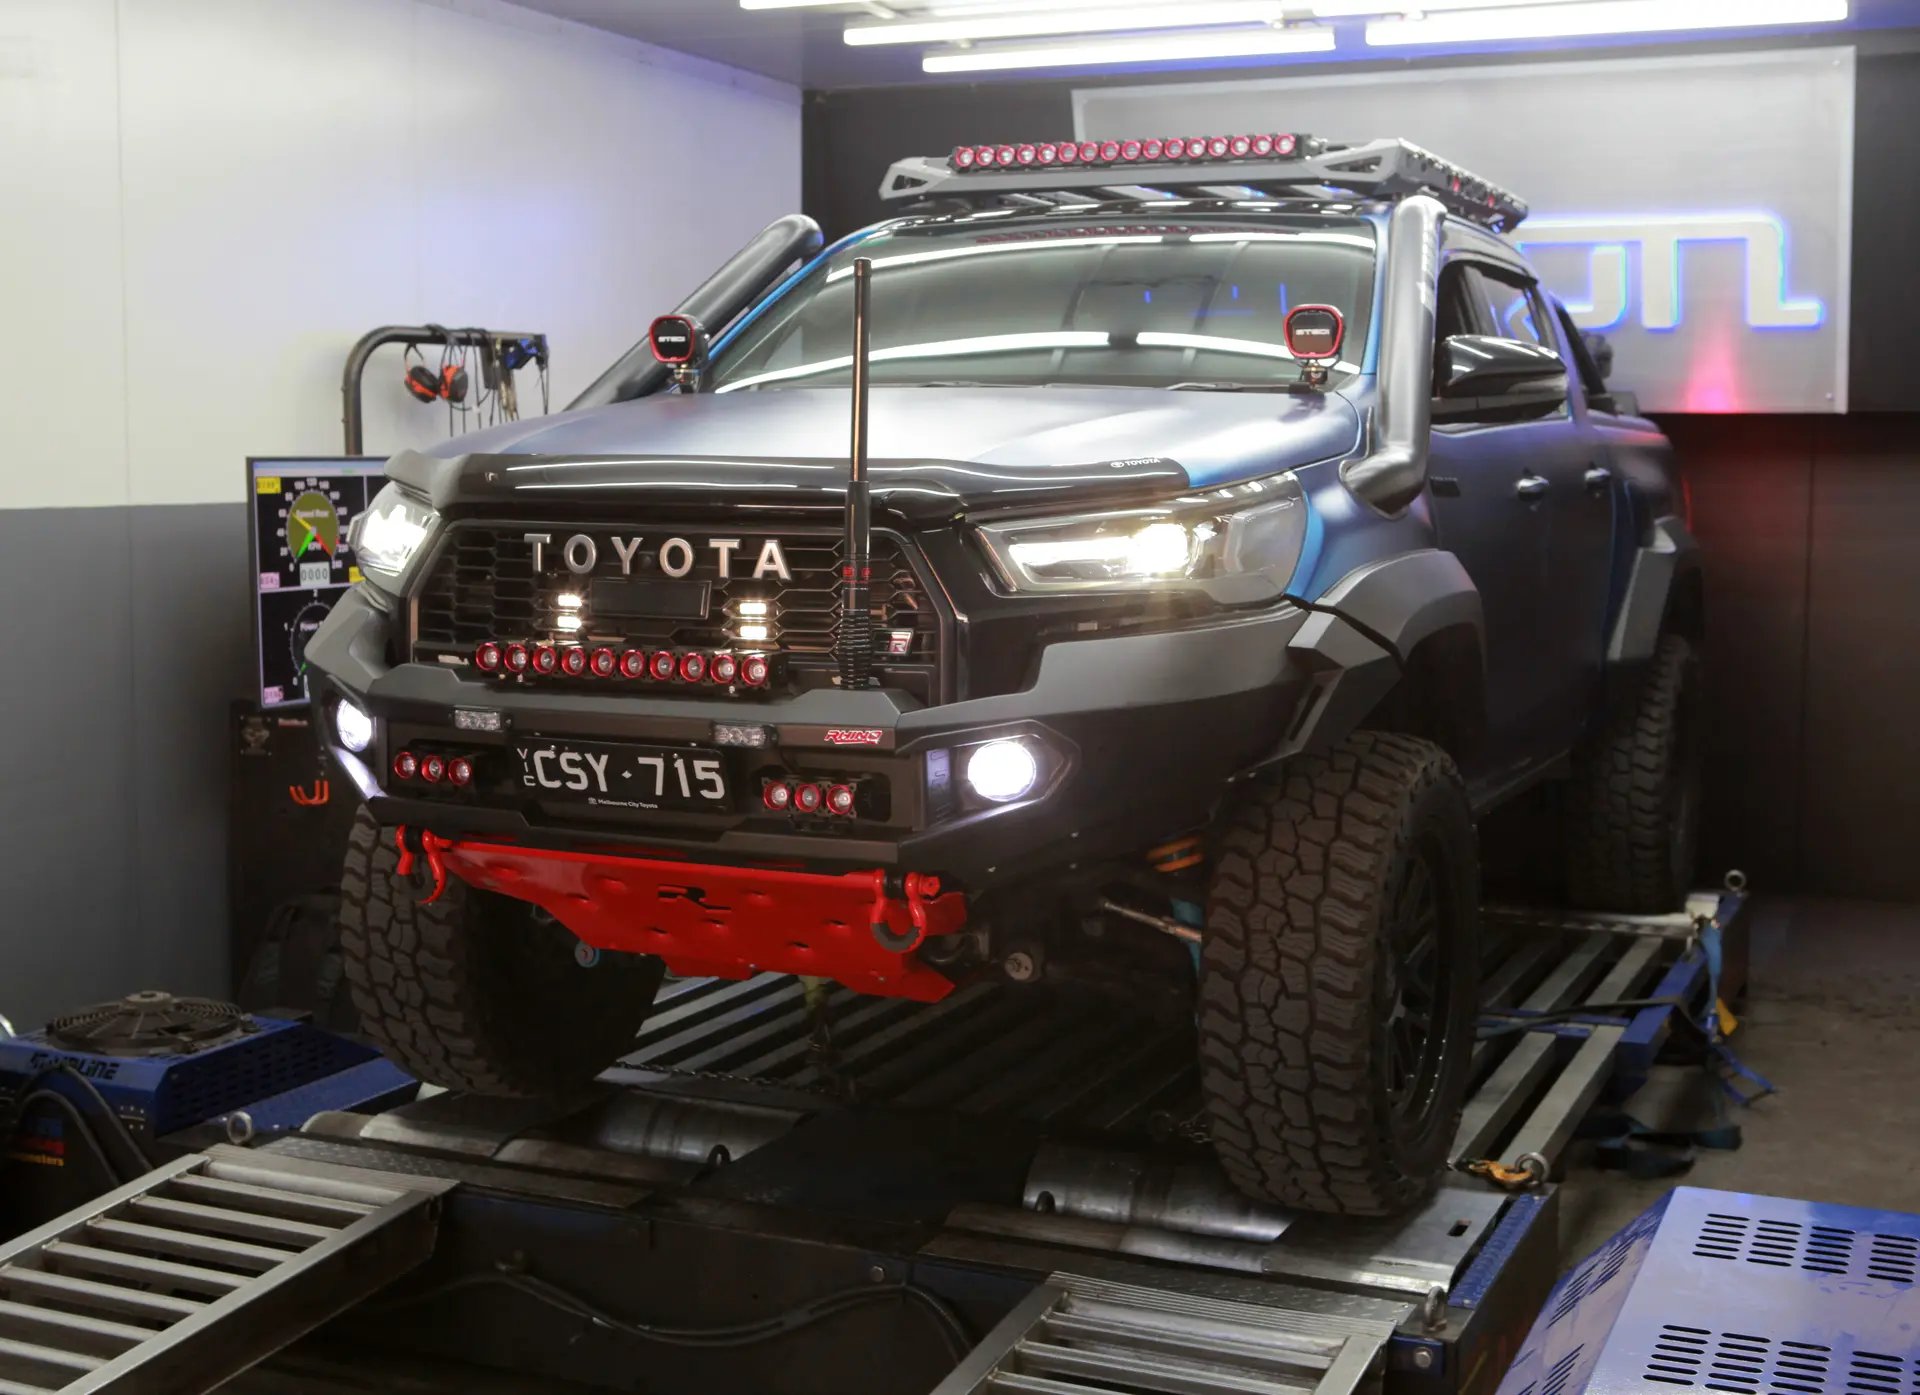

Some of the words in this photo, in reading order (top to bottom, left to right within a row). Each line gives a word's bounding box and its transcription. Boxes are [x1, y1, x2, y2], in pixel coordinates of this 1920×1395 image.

[1125, 458, 1161, 467] TOYOTA
[524, 533, 791, 580] TOYOTA
[517, 748, 536, 786] VIC
[533, 750, 609, 793] CSY
[637, 756, 725, 799] 715
